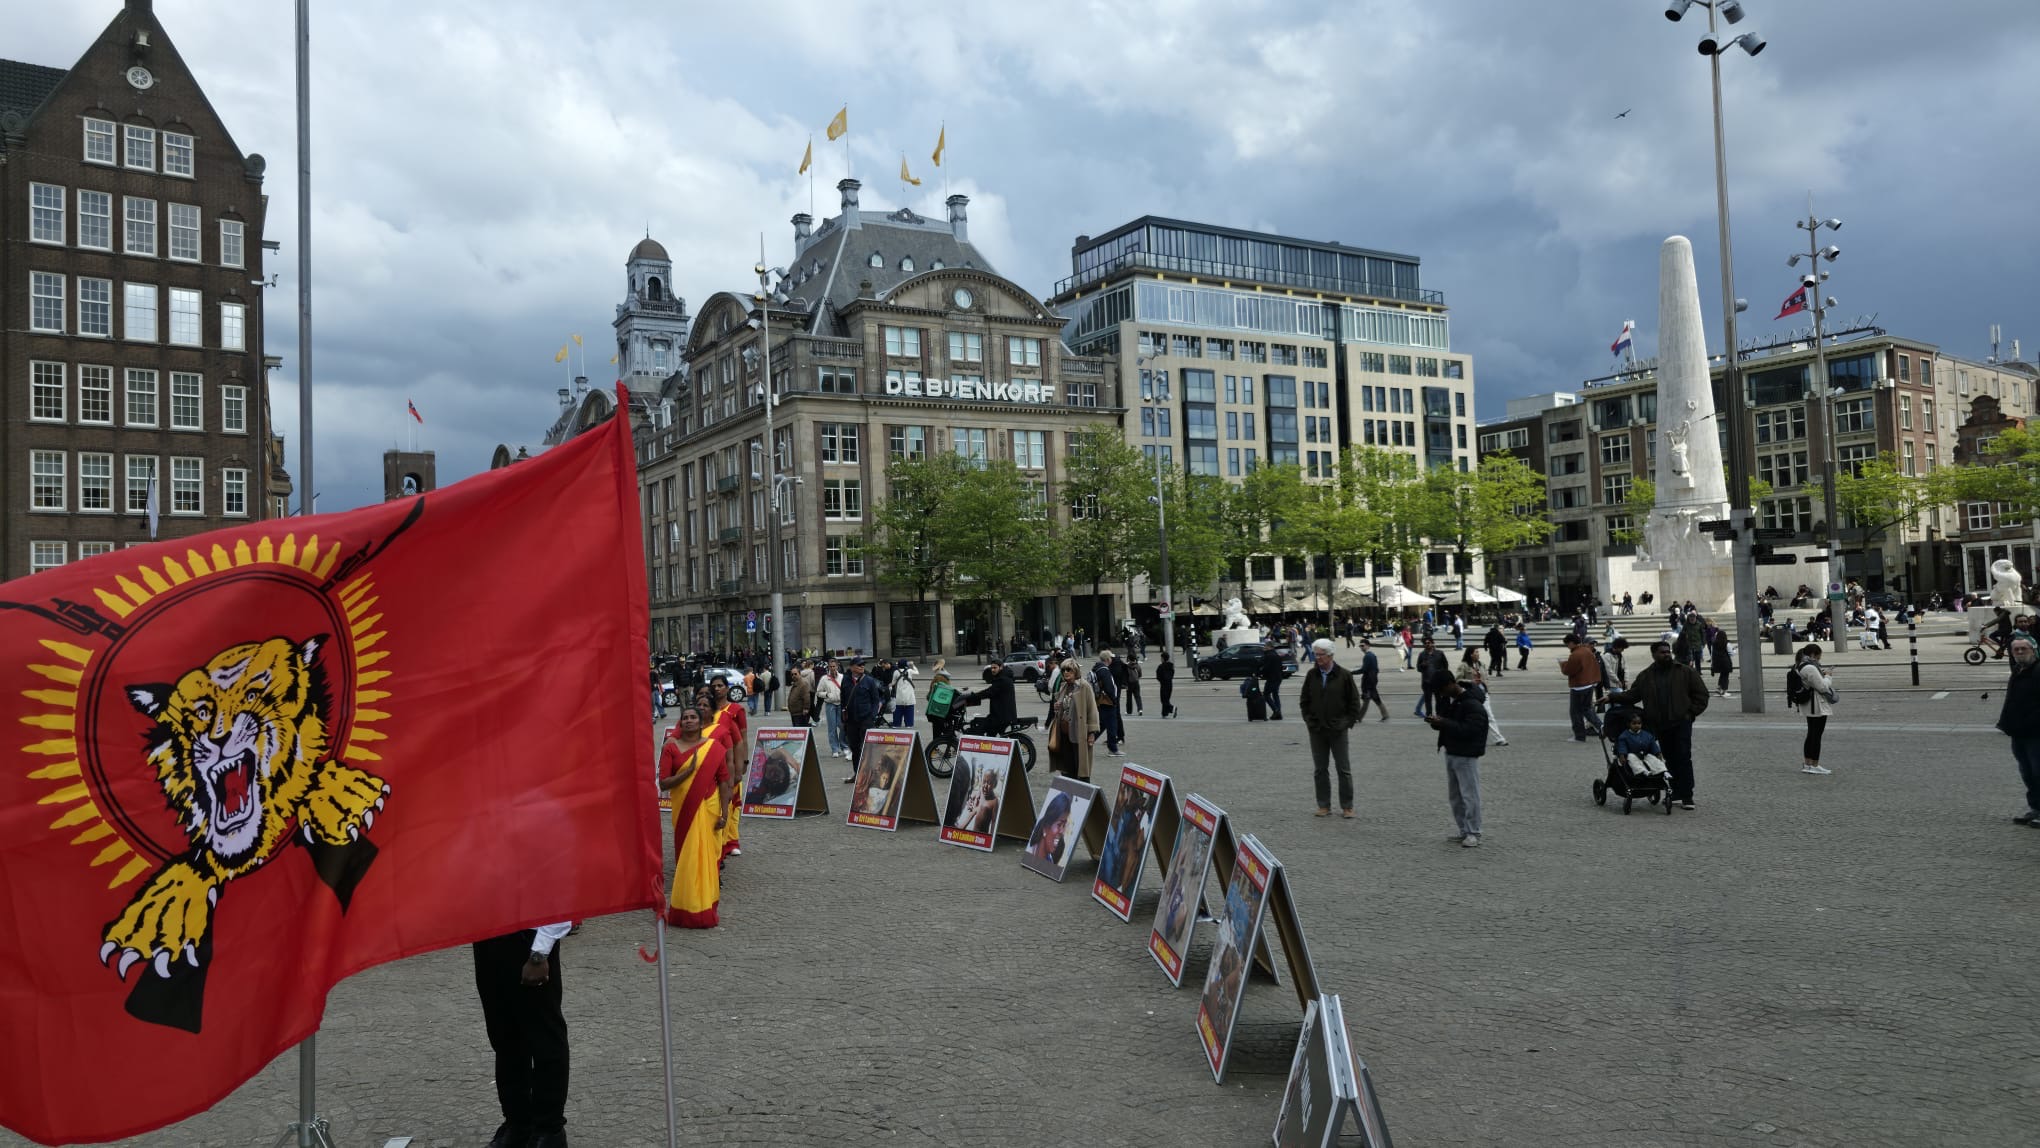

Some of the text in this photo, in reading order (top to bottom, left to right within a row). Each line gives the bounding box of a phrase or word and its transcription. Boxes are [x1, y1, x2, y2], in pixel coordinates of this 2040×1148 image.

[886, 376, 1056, 402] DE BIJENKORF
[776, 731, 788, 739] Tamil
[883, 734, 895, 742] Tamil
[979, 741, 992, 750] Tamil
